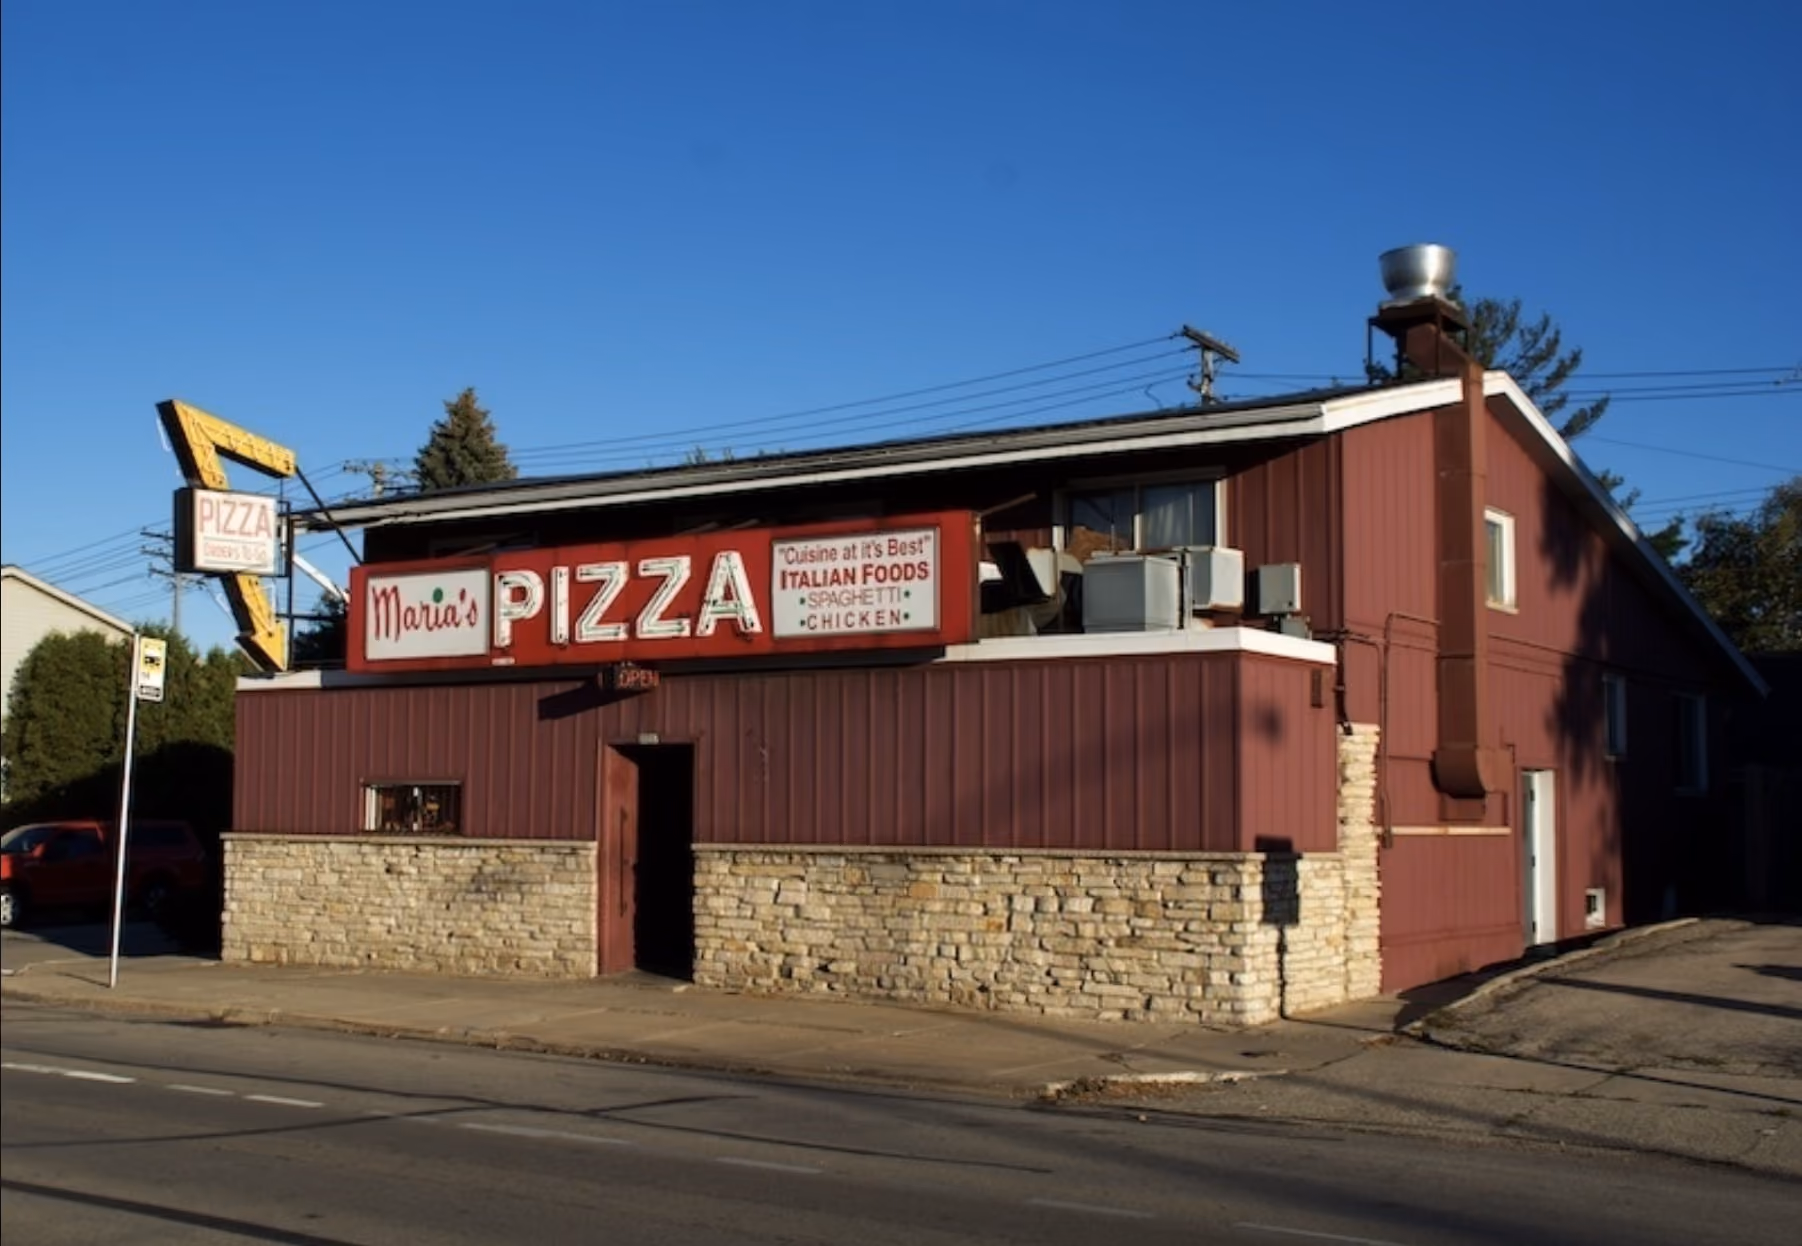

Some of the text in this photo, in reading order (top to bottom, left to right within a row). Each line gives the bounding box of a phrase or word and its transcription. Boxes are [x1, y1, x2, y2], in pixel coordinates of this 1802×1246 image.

[199, 497, 273, 539] PIZZA
[778, 535, 931, 565] "Cuisine at it's Best"
[780, 561, 929, 590] ITALIAN FOODS
[494, 550, 763, 648] PIZZA
[807, 586, 901, 609] SPAGHETTI
[372, 585, 478, 643] Maria's
[807, 609, 900, 630] CHICKEN
